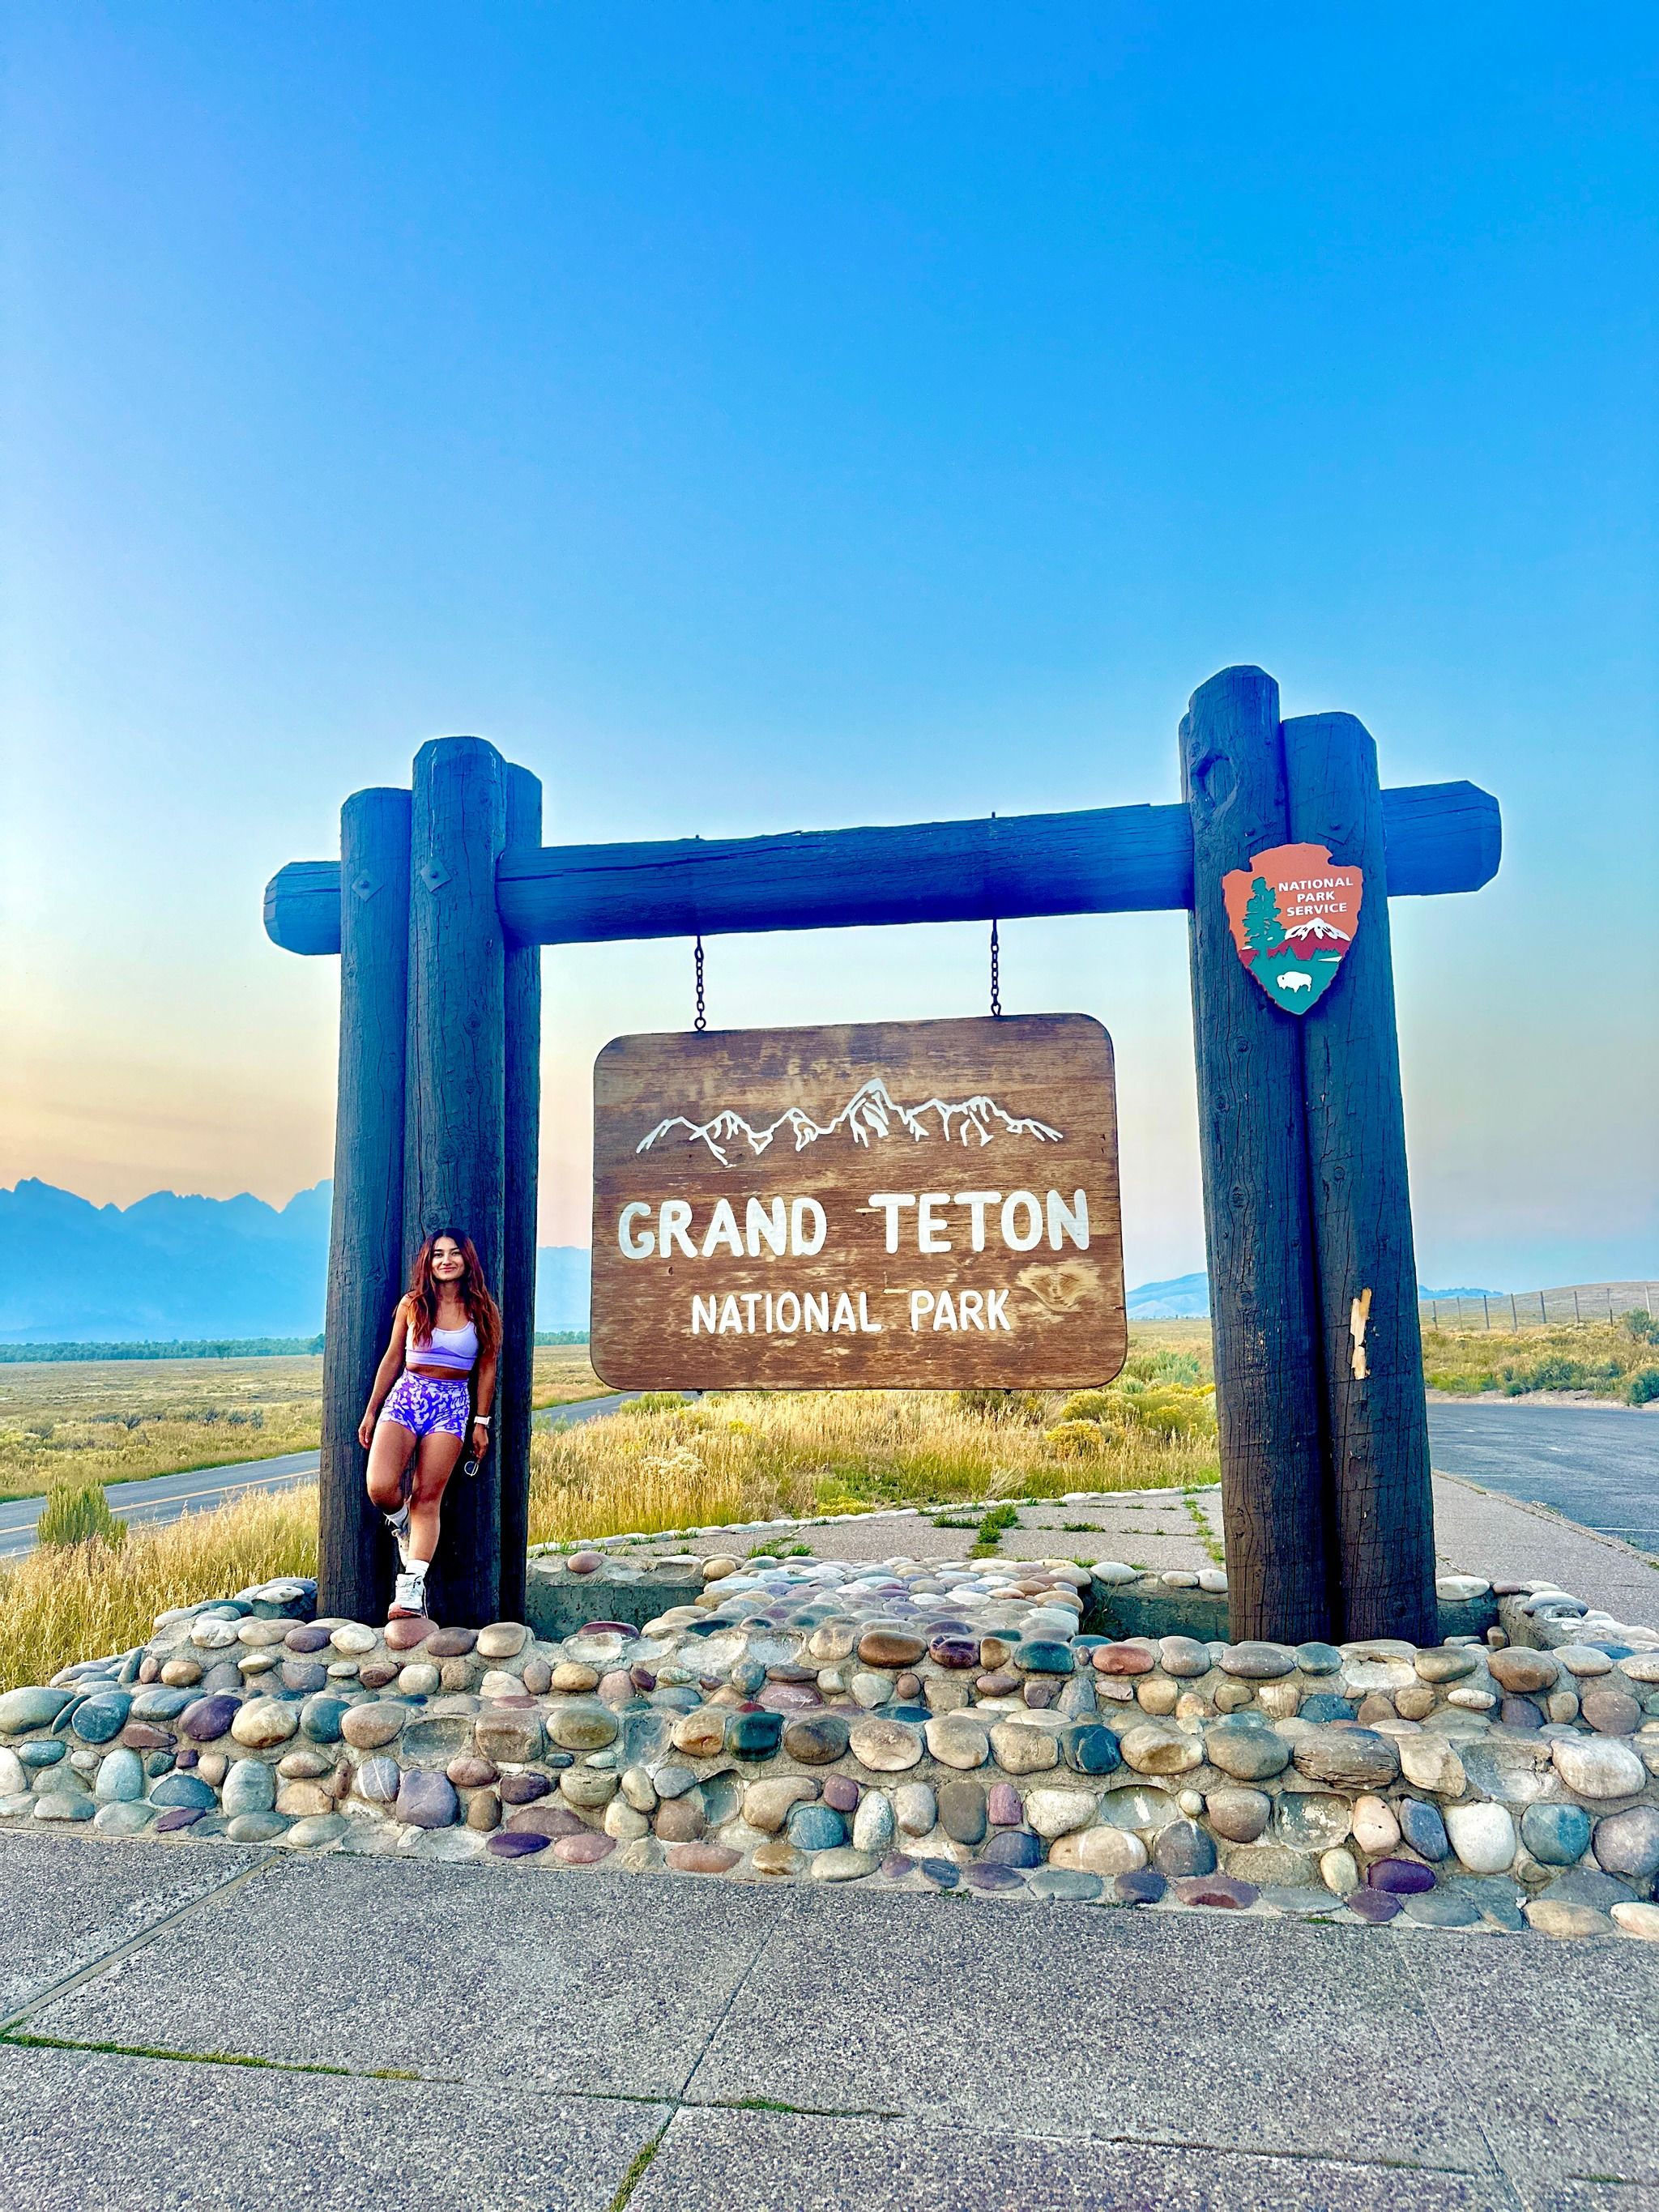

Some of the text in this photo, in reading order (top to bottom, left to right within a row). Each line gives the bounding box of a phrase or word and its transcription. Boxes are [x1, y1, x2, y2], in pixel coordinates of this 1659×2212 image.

[1278, 877, 1354, 892] NATIONAL
[1297, 891, 1335, 902] PARK
[1286, 902, 1347, 916] SERVICE
[618, 1189, 1090, 1259] GRAND TETON
[691, 1288, 1011, 1335] NATIONAL PARK
